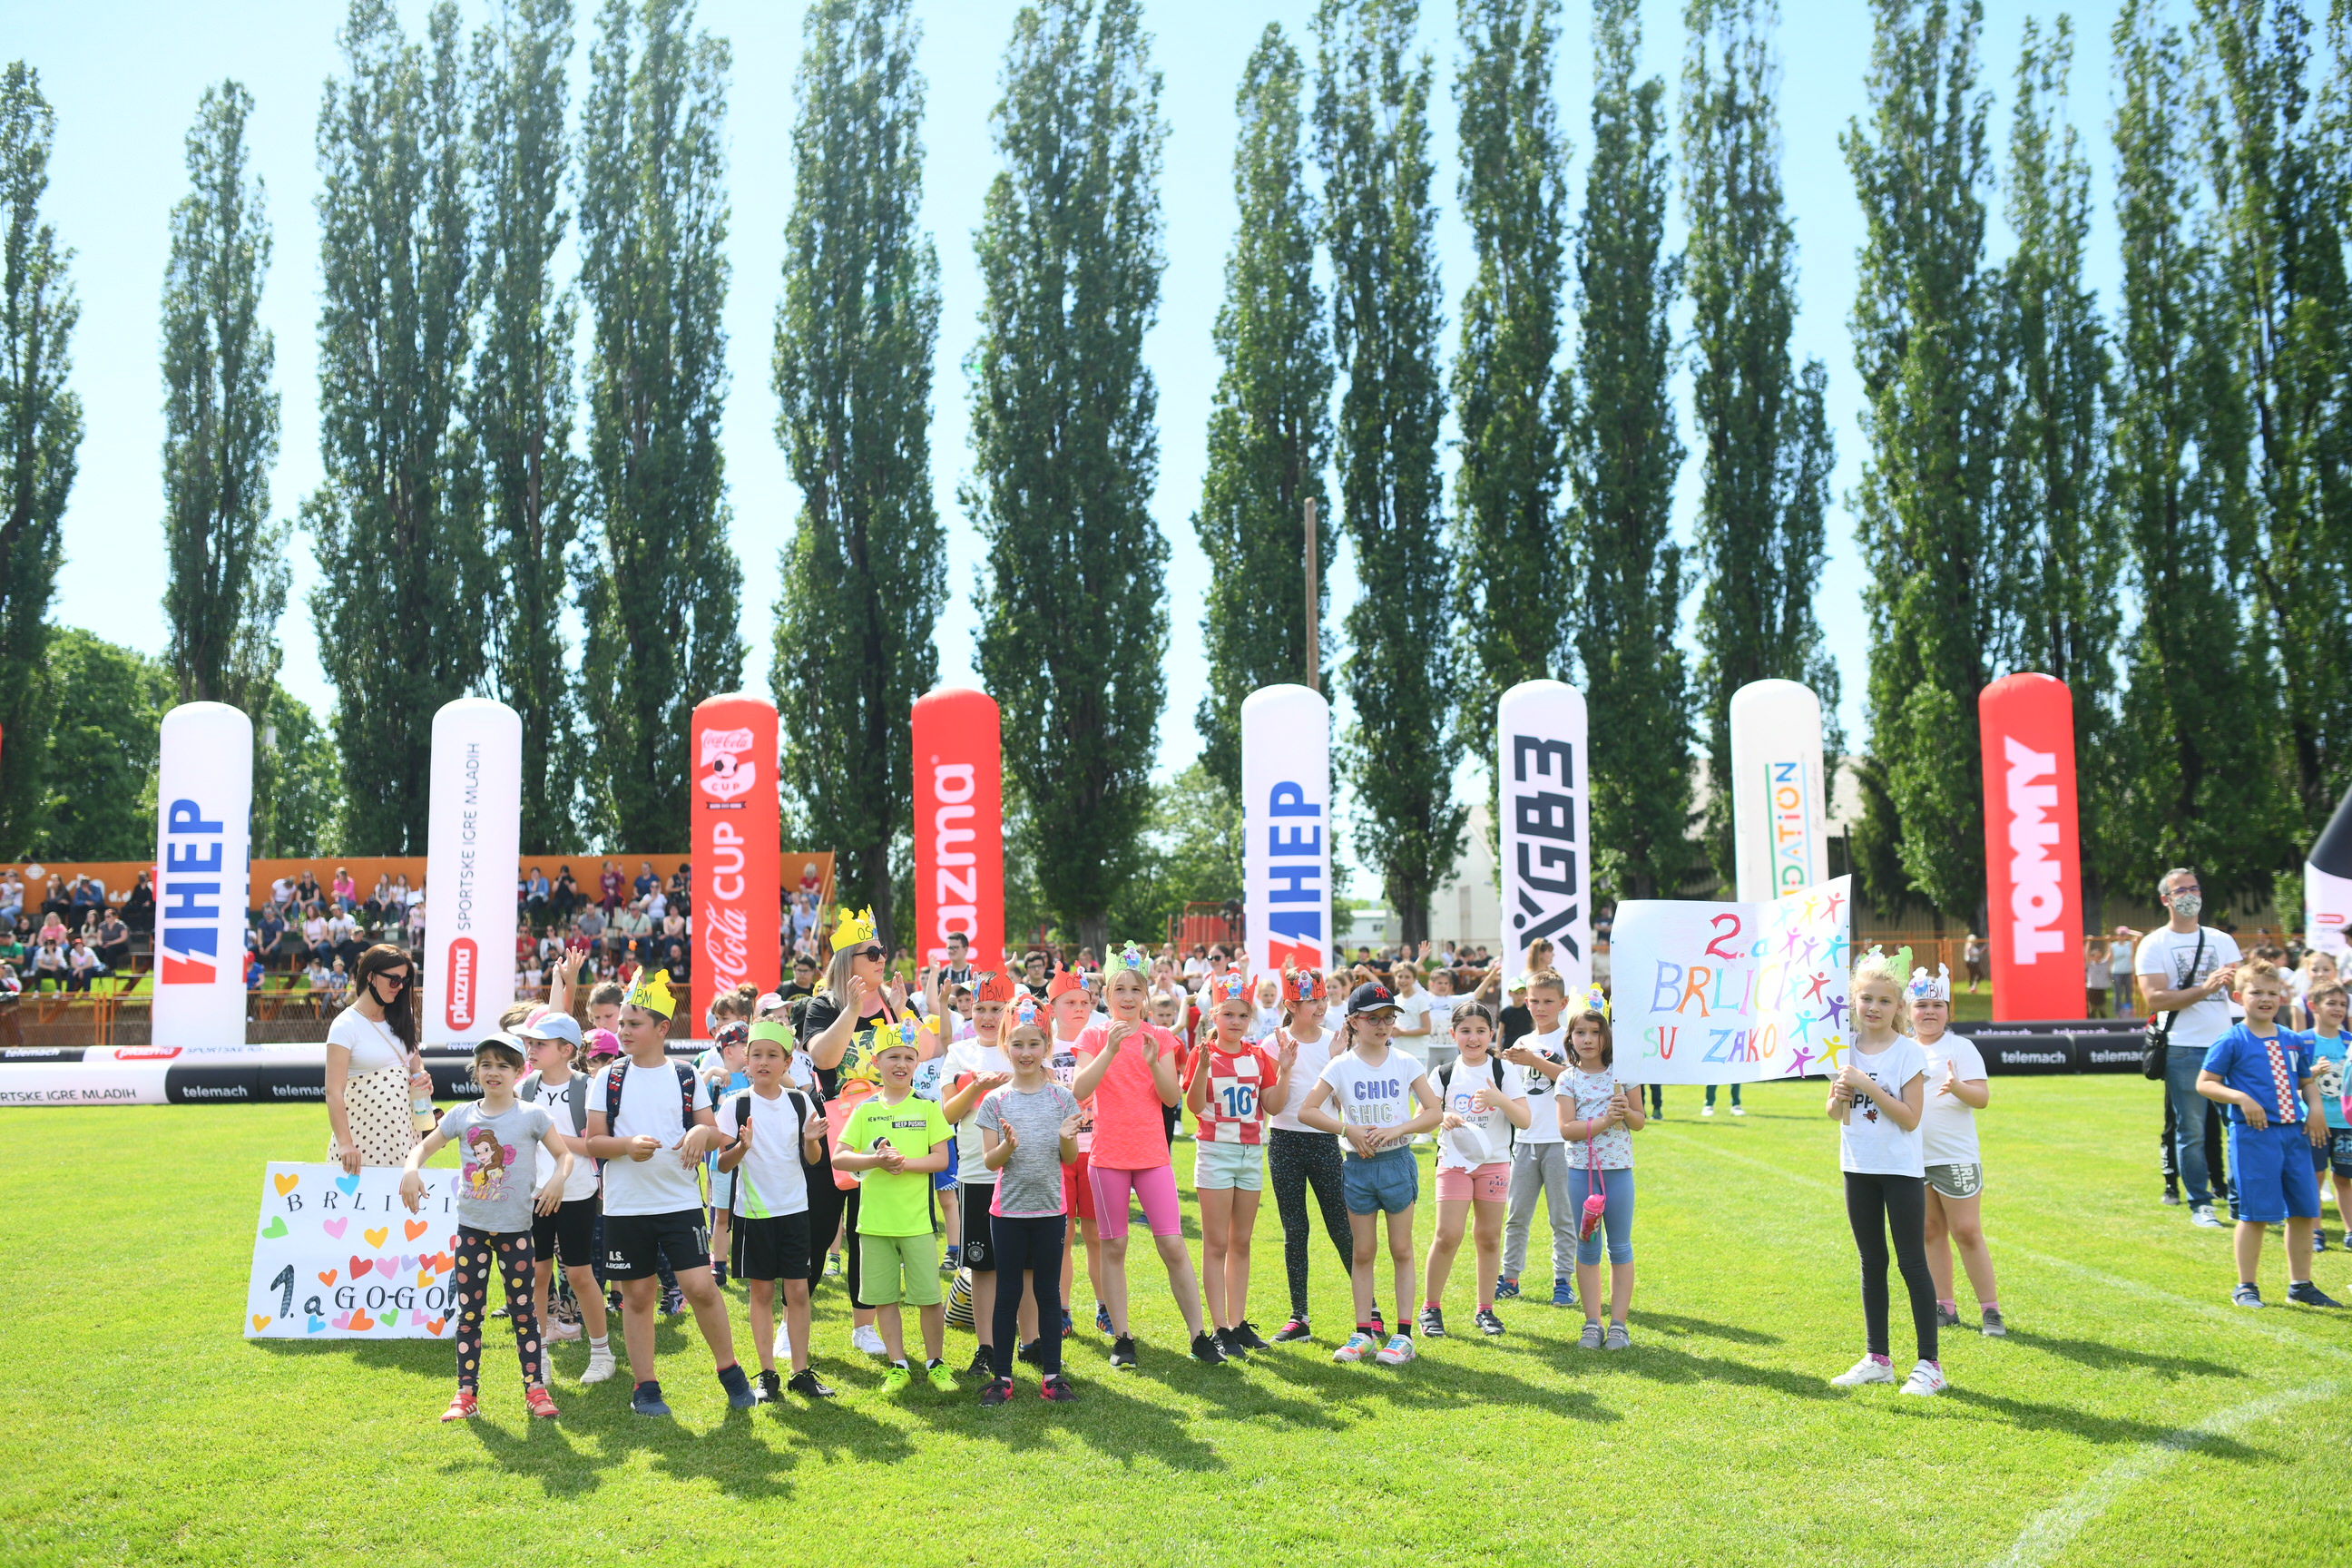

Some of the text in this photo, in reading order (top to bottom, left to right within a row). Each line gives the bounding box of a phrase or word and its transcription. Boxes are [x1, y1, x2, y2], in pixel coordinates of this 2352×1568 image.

[711, 783, 740, 791] CUP
[458, 742, 480, 931] SPORTSKE IGRE MLADIH
[1269, 780, 1321, 904] HEP
[1513, 734, 1579, 963] XGB3
[2004, 735, 2065, 965] TOMMY
[164, 799, 224, 919] HEP
[712, 821, 745, 901] CUP
[927, 763, 978, 960] lazma
[449, 948, 471, 1024] plazma
[982, 985, 1005, 1001] IBM
[1642, 1026, 1678, 1060] SU
[2001, 1051, 2066, 1064] telemach
[0, 1088, 137, 1102] RTSKE IGRE MLADIH
[182, 1085, 248, 1098] telemach
[1222, 1085, 1252, 1117] 10
[1354, 1079, 1399, 1101] CHIC
[1349, 1103, 1393, 1124] CHIC
[605, 1261, 632, 1269] LEGEA
[609, 1250, 624, 1261] A.S.
